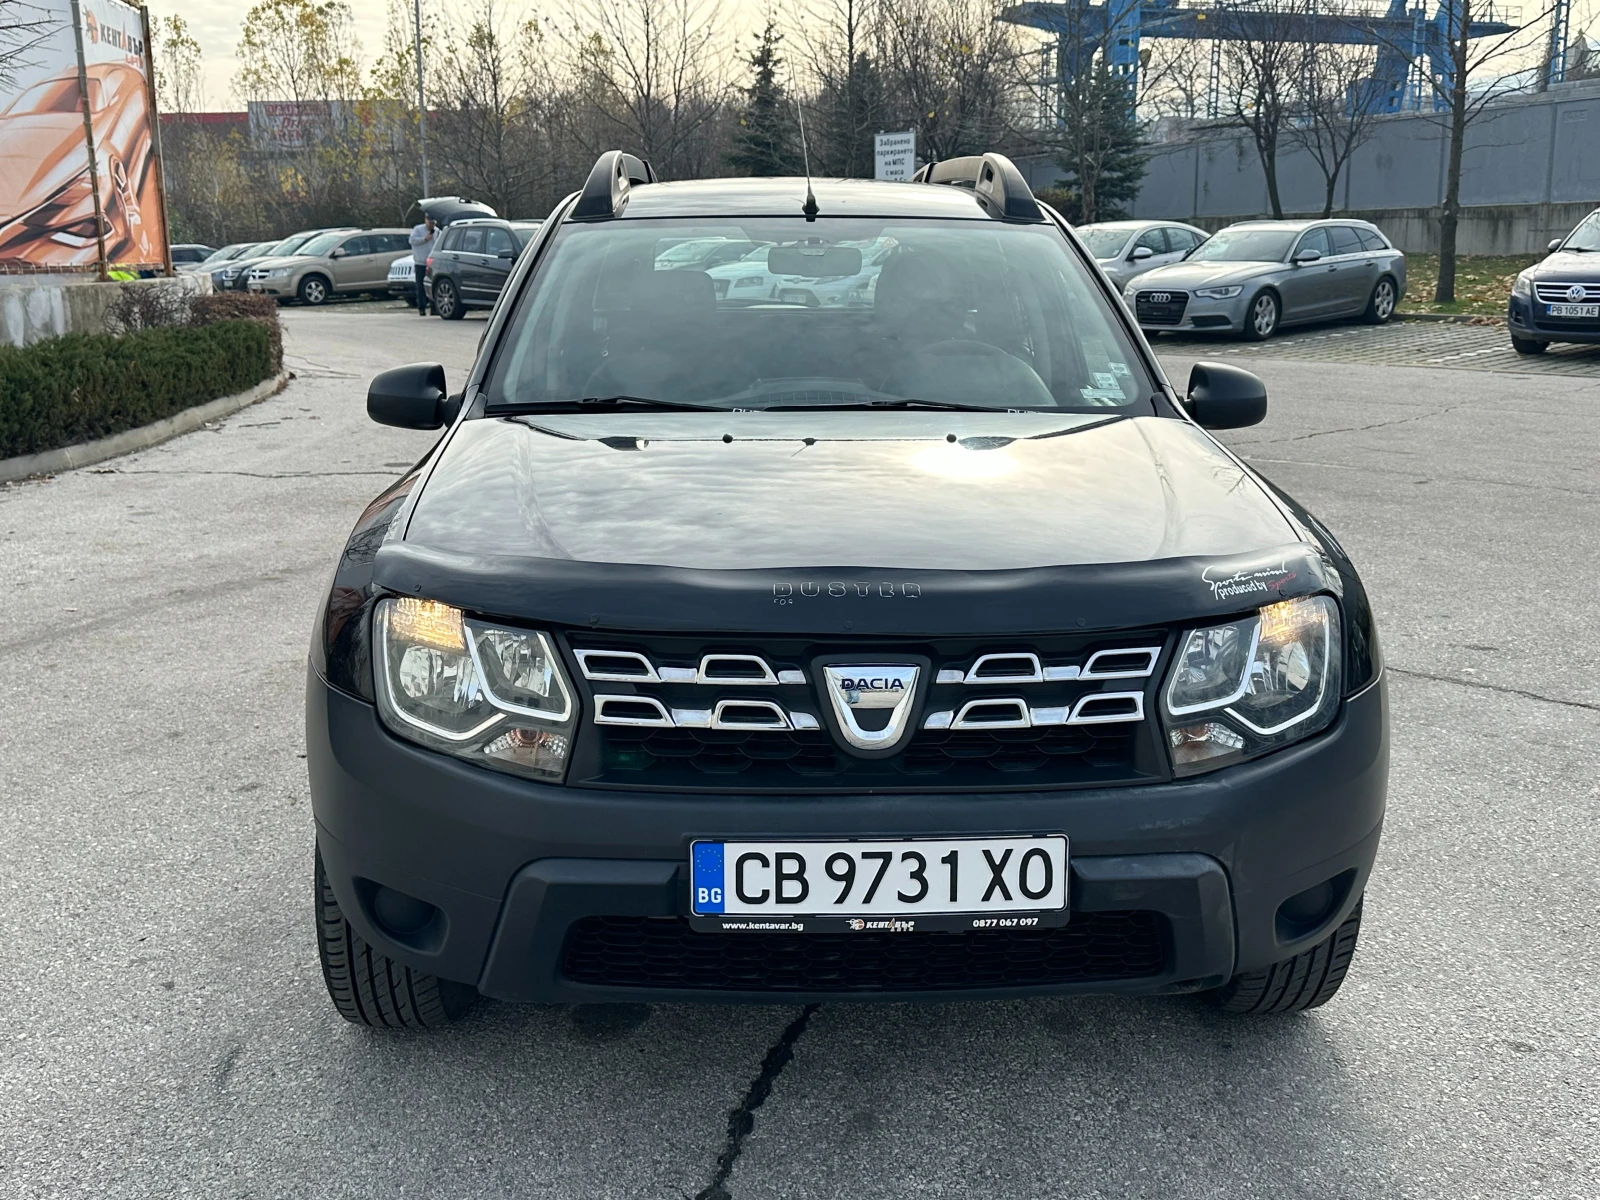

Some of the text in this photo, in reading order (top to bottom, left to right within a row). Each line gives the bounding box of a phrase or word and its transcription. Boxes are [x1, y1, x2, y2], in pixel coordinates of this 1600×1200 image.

[100, 21, 143, 57] КЕНТАВЪР
[879, 138, 911, 147] Забранено
[876, 148, 913, 157] паркирането
[892, 157, 905, 166] МПС
[1552, 306, 1562, 315] PB
[1565, 306, 1583, 315] 1051
[1585, 307, 1597, 316] AE
[1218, 580, 1257, 600] produced
[1255, 579, 1268, 592] by
[841, 678, 904, 690] DACIA
[697, 848, 1054, 905] BG CB 9731 XO
[722, 922, 804, 932] www.kentavar.bg
[972, 917, 1039, 928] 0877 067 097
